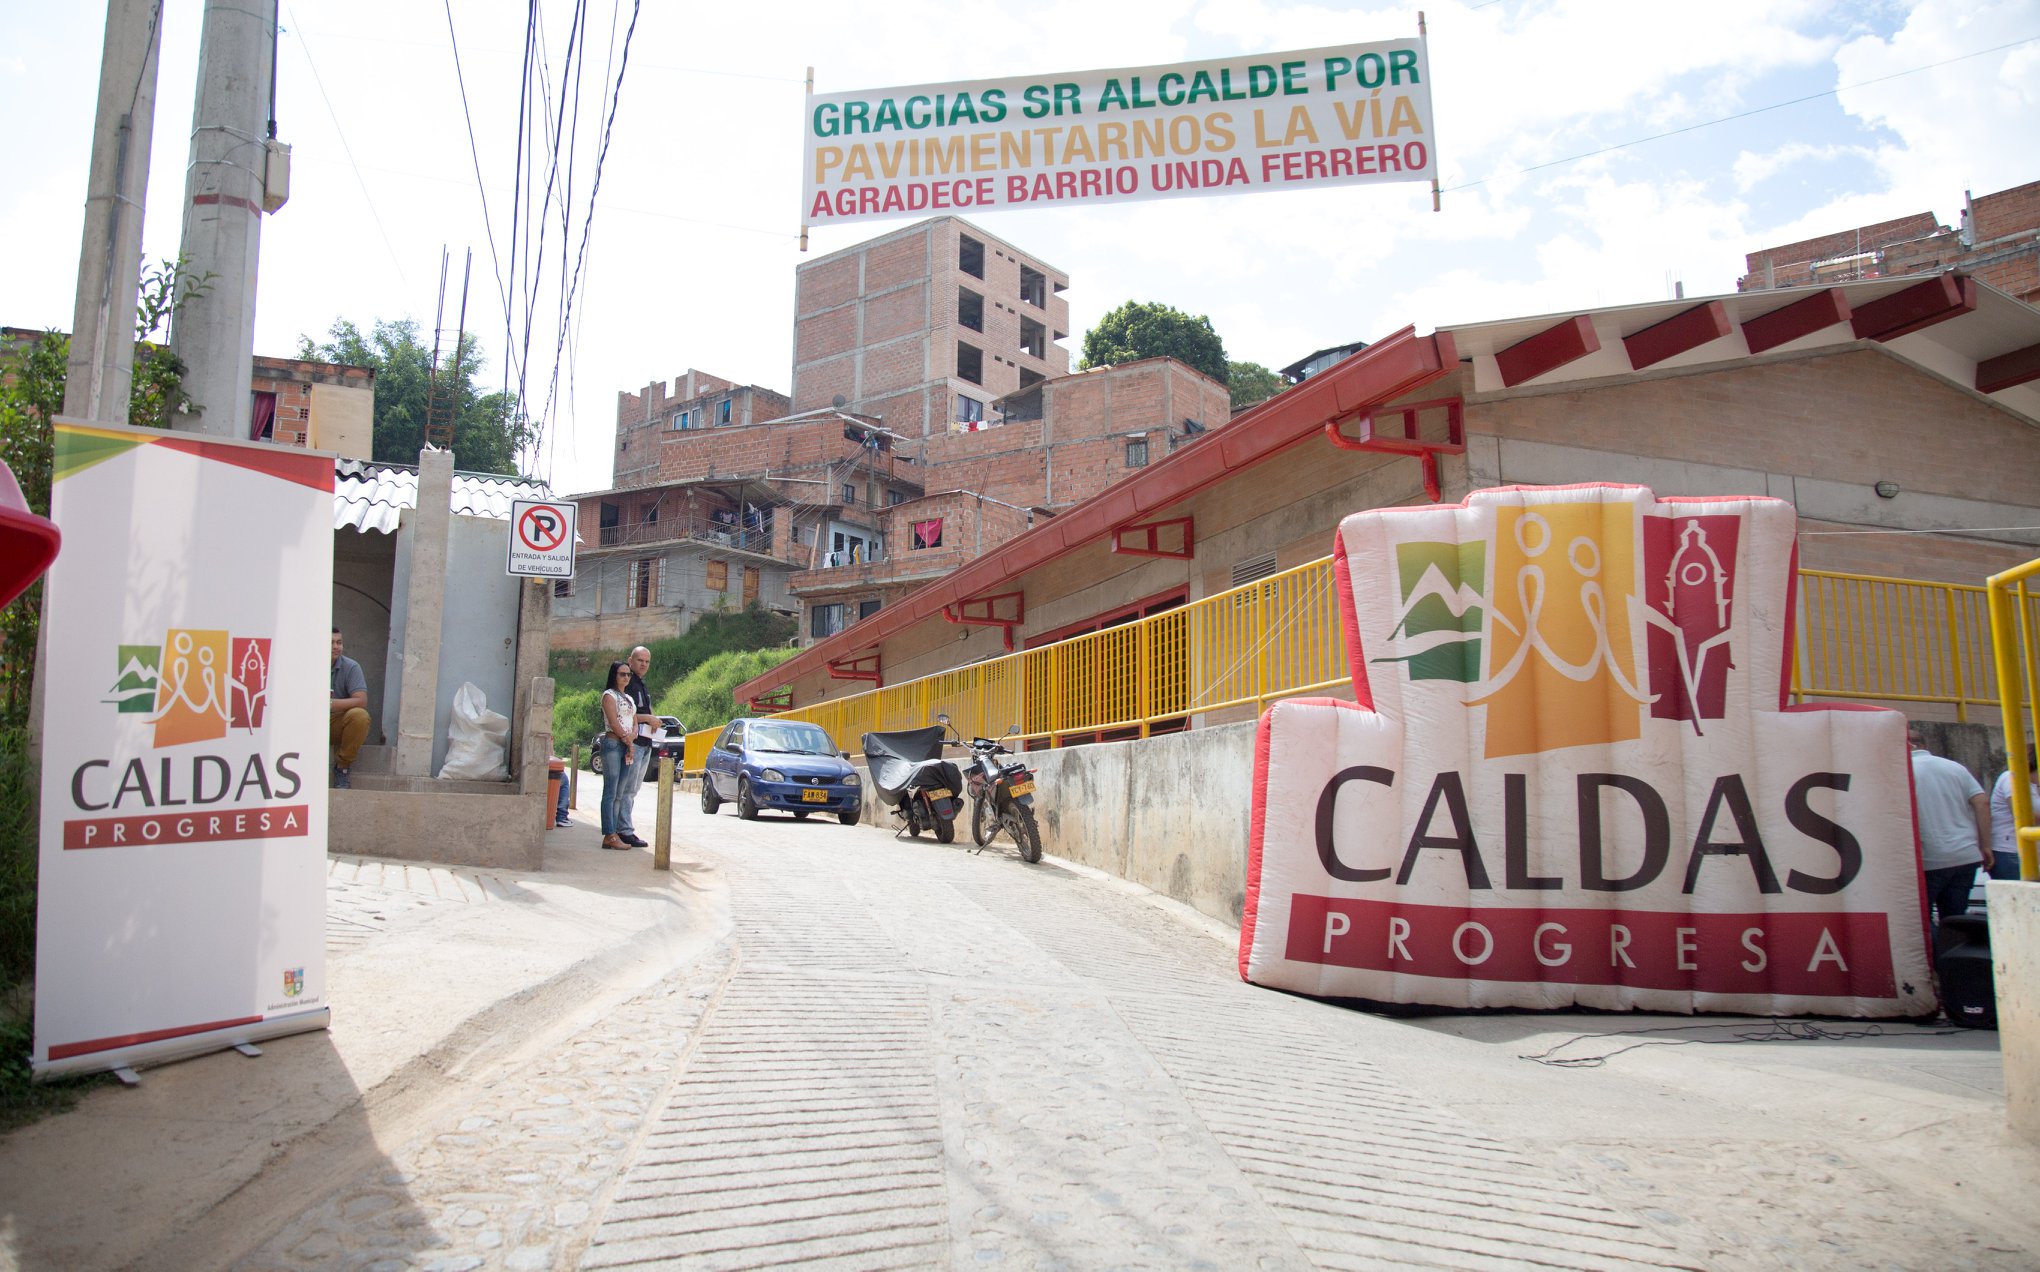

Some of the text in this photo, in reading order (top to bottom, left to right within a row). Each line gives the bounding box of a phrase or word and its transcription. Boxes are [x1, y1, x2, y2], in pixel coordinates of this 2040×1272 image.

[813, 49, 1420, 137] GRACIAS SR ALCALDE POR
[816, 90, 1424, 185] PAVIMENTARNOS LA VÍA
[811, 141, 1428, 218] AGRADECE BARRIO UNDA FERRERO
[528, 564, 562, 572] VEHÍCULOS
[71, 752, 301, 811] CALDAS
[85, 811, 299, 845] PROGRESA
[1315, 765, 1863, 895] CALDAS
[1323, 912, 1848, 972] PROGRESA
